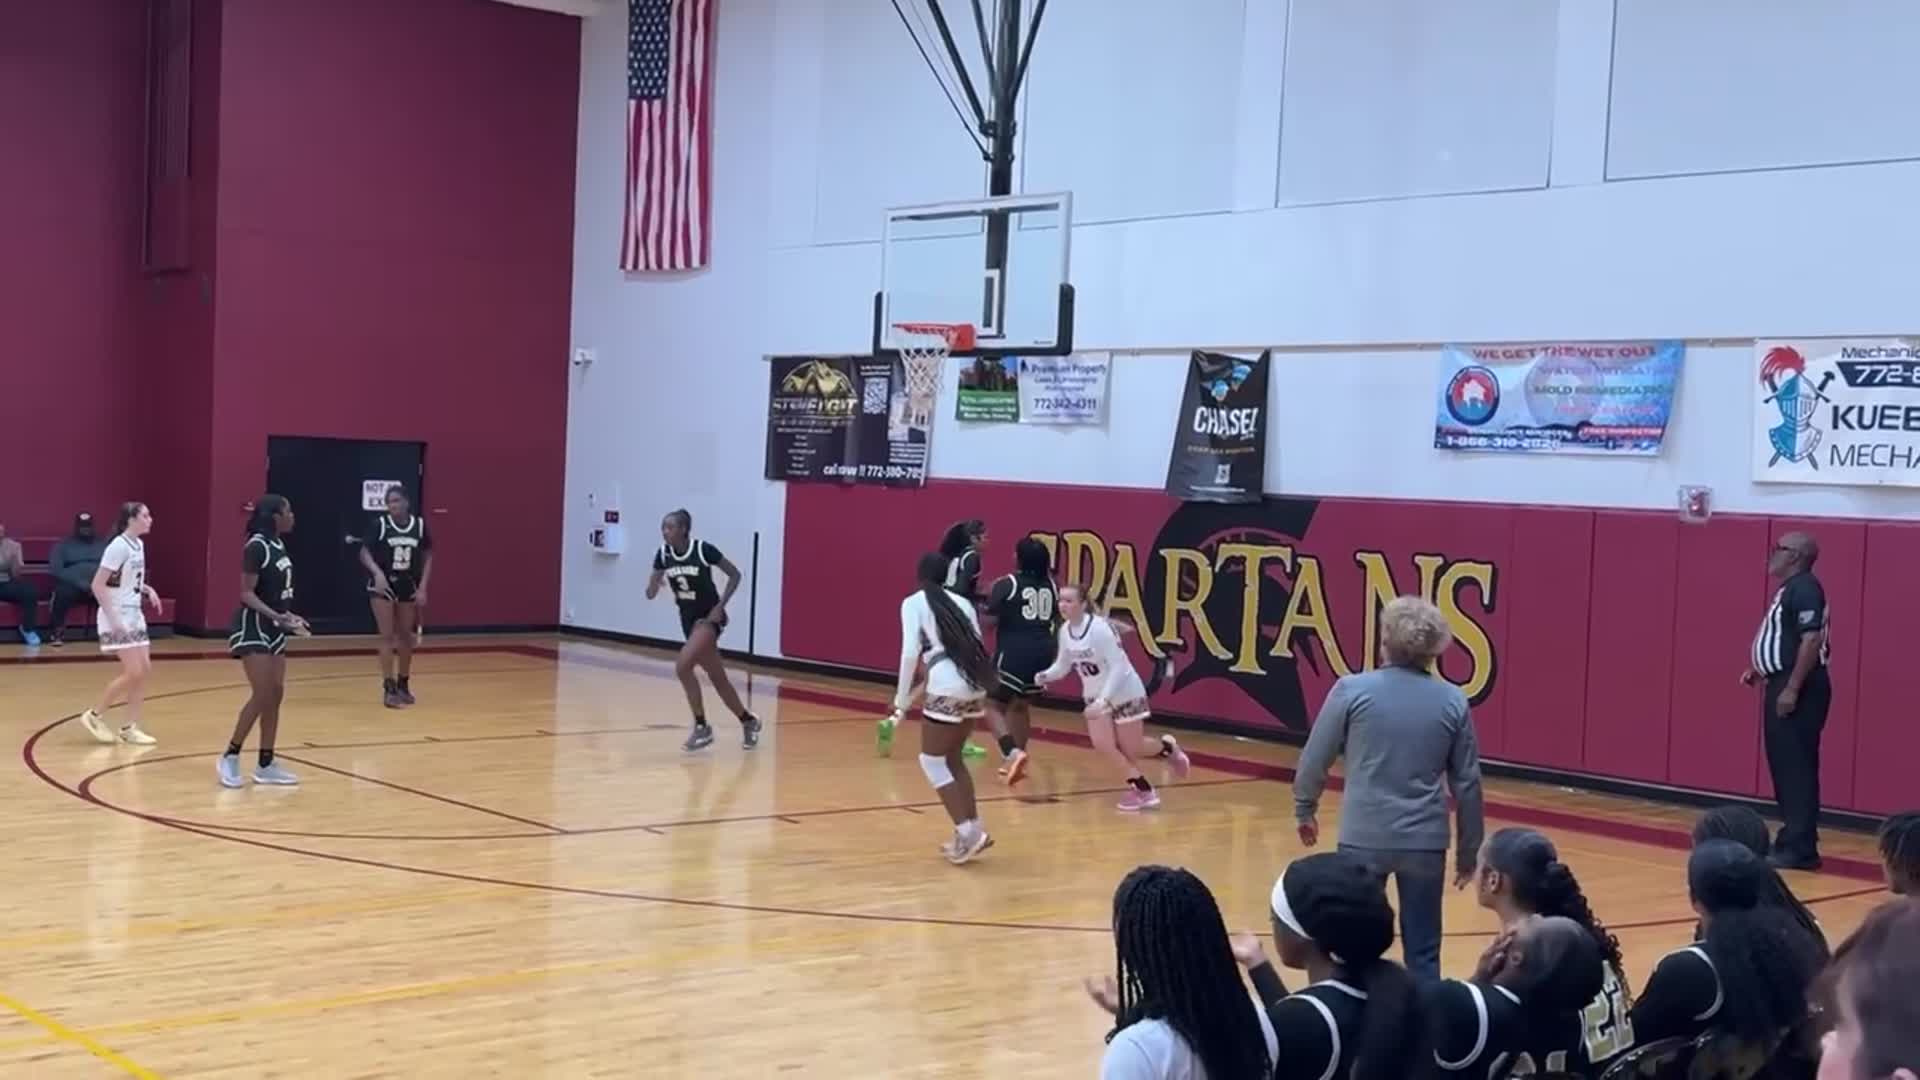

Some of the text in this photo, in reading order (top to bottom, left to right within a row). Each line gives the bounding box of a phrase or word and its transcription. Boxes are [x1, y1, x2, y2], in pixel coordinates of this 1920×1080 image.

[1193, 405, 1258, 436] CHASE!
[368, 497, 384, 507] EX
[1021, 586, 1053, 620] 30
